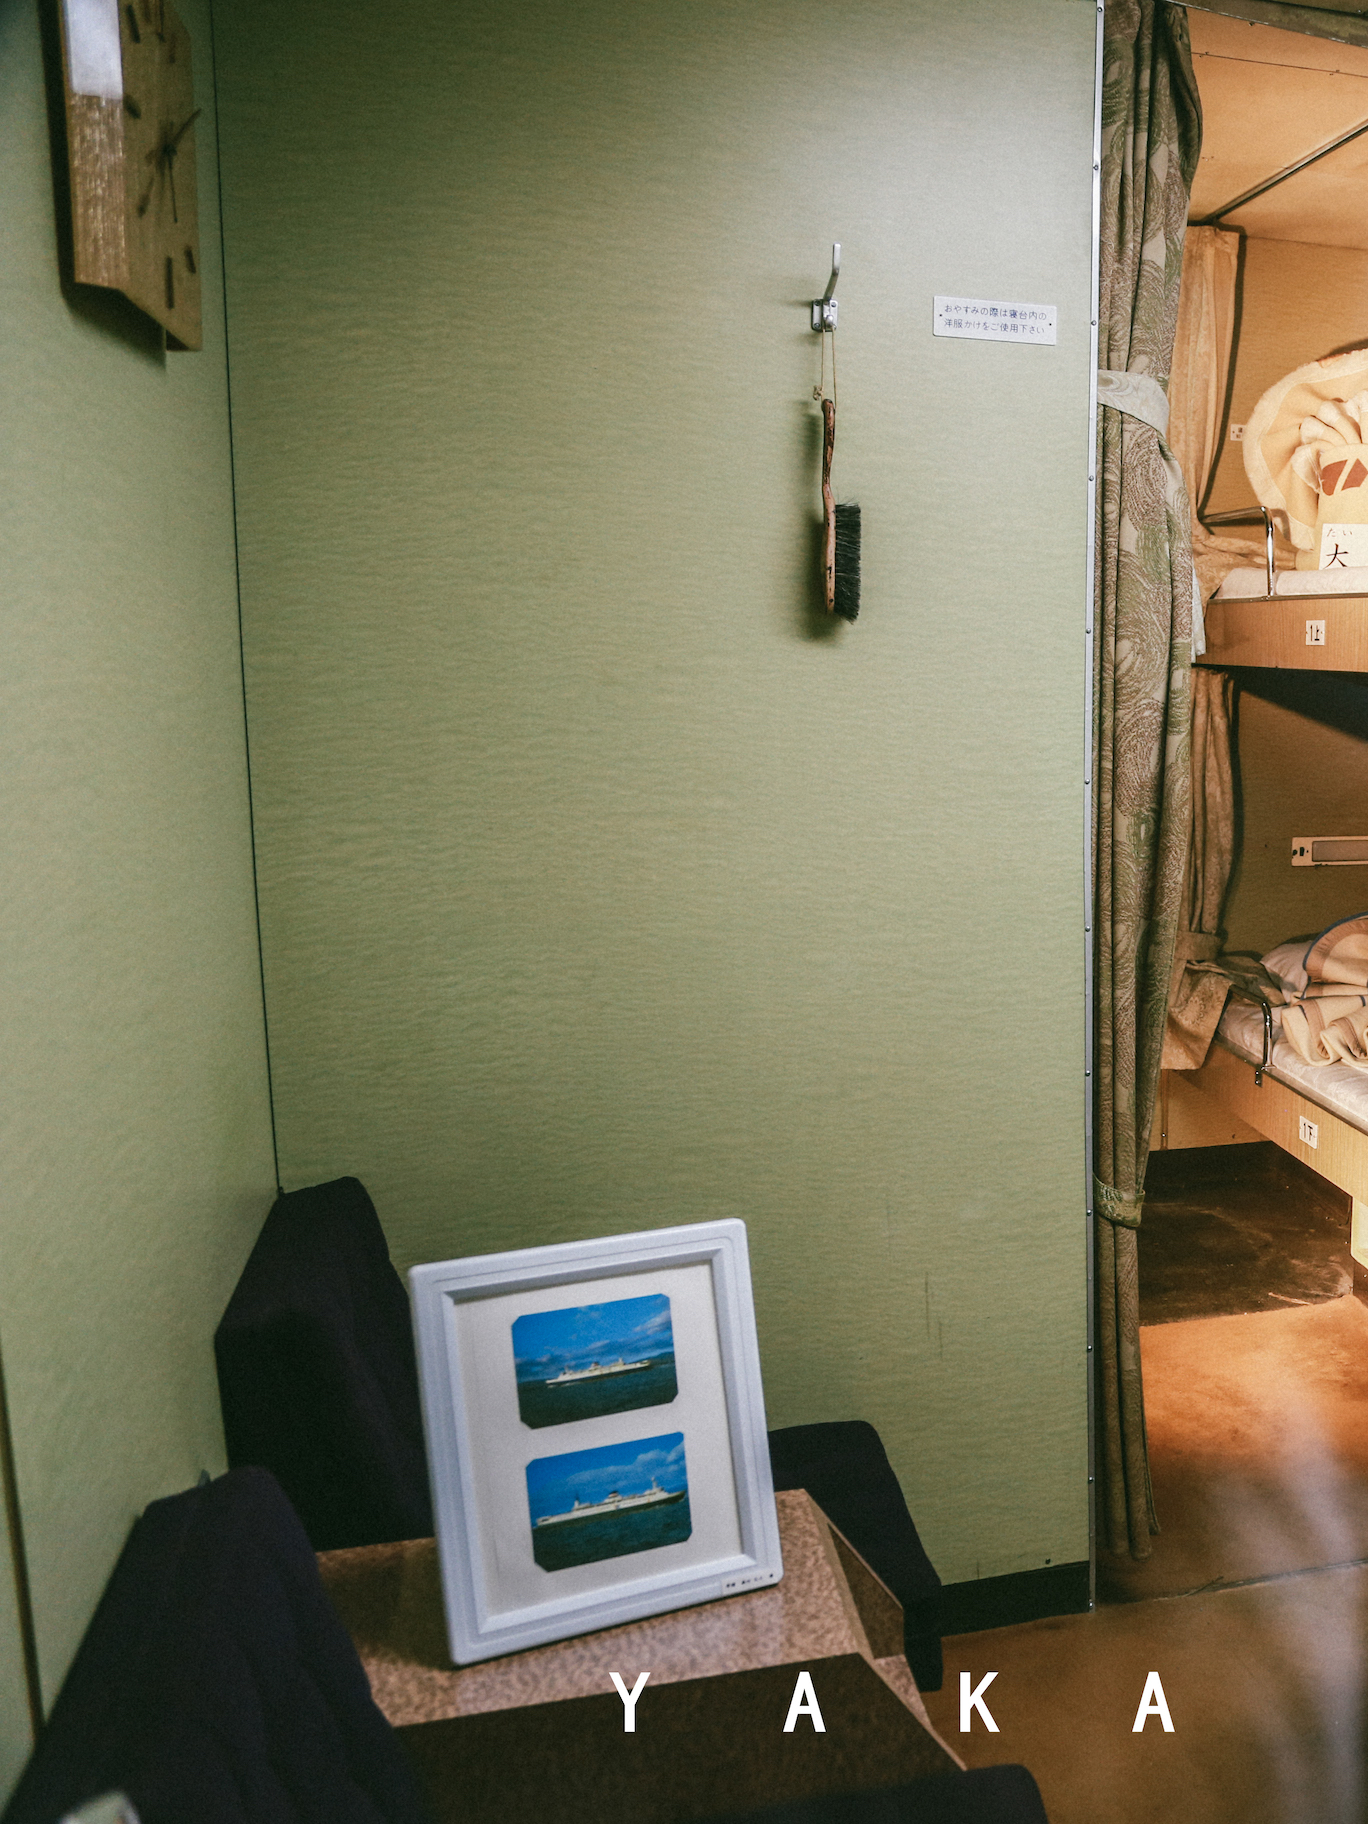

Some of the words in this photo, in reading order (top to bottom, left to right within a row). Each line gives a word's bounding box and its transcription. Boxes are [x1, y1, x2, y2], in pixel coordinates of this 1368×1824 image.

[944, 304, 1047, 320] おやすみの際は寝台内の
[944, 318, 1045, 335] 洋服かけをご使用下さい
[1323, 543, 1350, 570] 大
